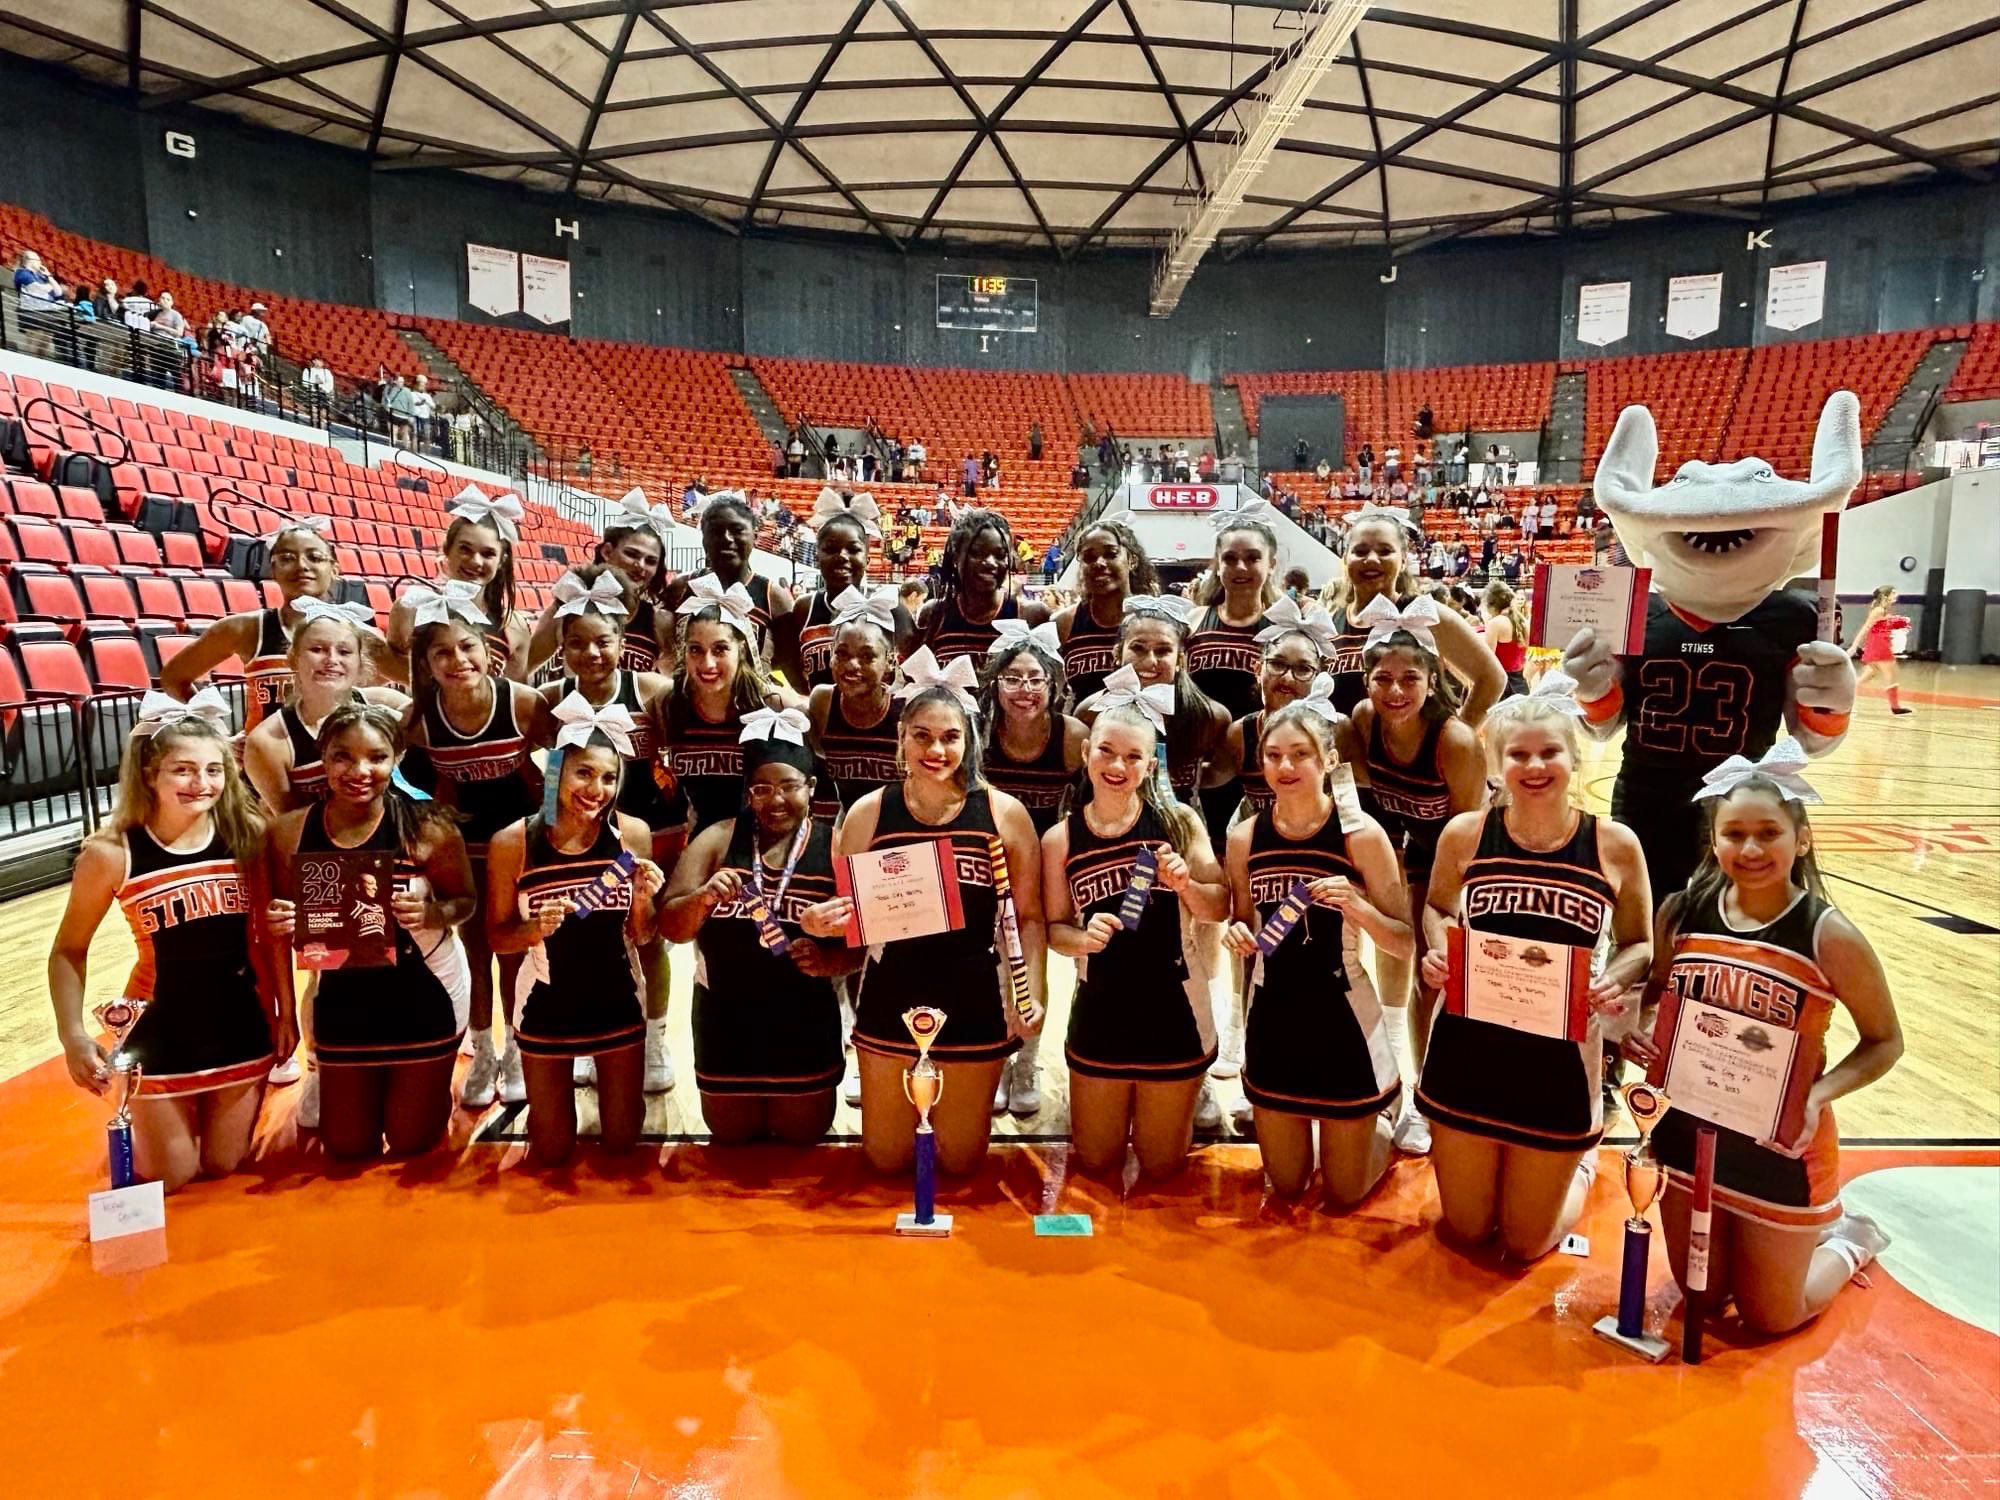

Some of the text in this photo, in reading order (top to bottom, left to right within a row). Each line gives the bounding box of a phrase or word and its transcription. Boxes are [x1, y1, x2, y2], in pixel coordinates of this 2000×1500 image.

[165, 131, 196, 159] G
[555, 218, 579, 240] H
[1747, 228, 1774, 250] K
[1380, 265, 1397, 283] J
[981, 335, 989, 352] I
[1681, 642, 1714, 654] STINGS
[1640, 659, 1753, 755] 23
[674, 750, 744, 776] STING
[301, 861, 340, 884] 20
[1469, 883, 1602, 935] STINGS
[1667, 963, 1799, 1029] STINGS
